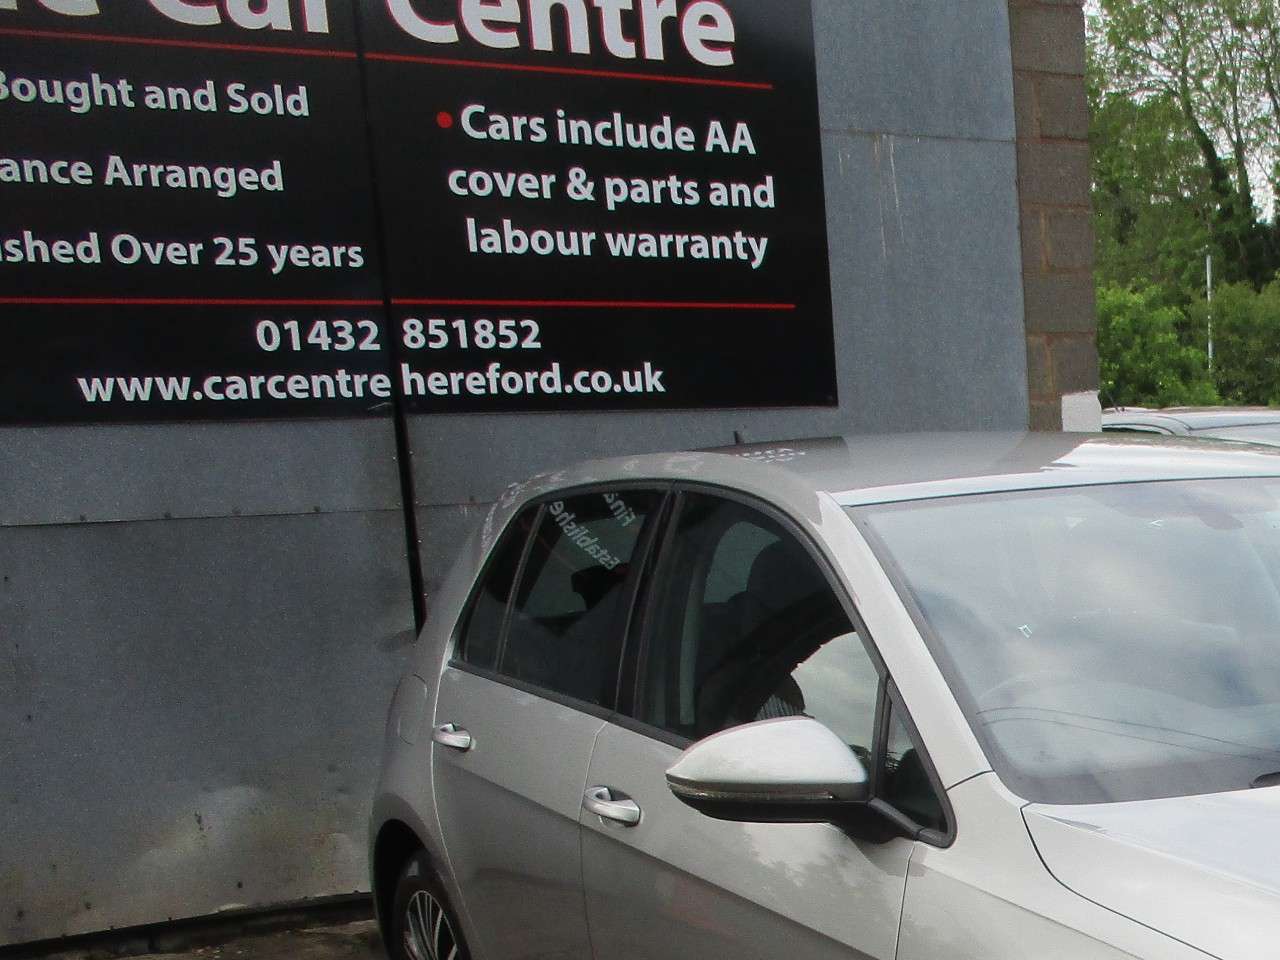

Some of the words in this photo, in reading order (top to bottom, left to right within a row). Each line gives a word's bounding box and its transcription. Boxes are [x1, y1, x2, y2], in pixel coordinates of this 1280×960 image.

[145, 80, 217, 112] and
[227, 83, 310, 117] Sold
[460, 104, 548, 142] Cars
[556, 108, 696, 152] include
[705, 120, 757, 155] AA
[104, 155, 284, 198] Arranged
[448, 169, 556, 199] cover
[566, 166, 596, 201] &
[604, 174, 701, 210] parts
[709, 175, 775, 209] and
[0, 230, 101, 264] shed
[111, 233, 204, 265] Over
[213, 236, 259, 266] 25
[267, 244, 364, 275] years
[466, 217, 597, 256] labour
[604, 230, 769, 270] warranty
[255, 319, 381, 352] 01432
[402, 318, 542, 350] 851852
